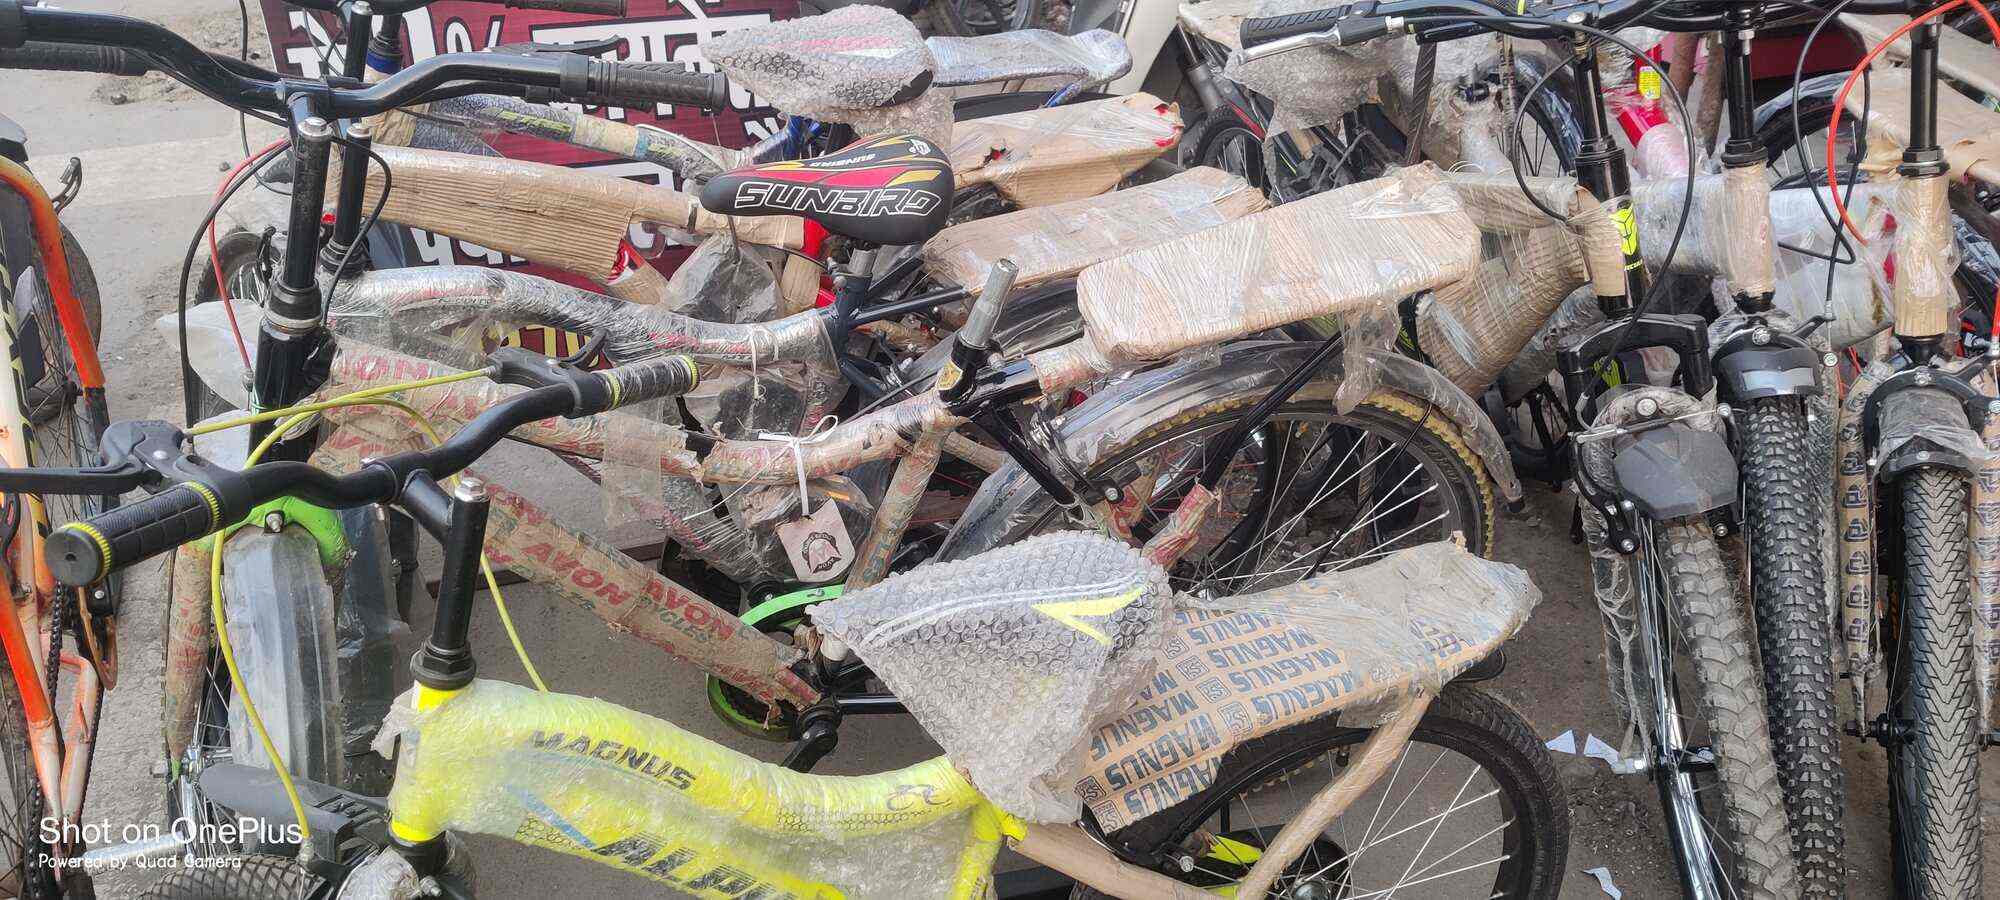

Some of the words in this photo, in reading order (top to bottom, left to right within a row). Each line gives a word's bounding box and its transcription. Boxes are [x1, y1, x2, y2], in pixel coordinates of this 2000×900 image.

[734, 181, 942, 217] SUNBIRD
[520, 542, 632, 606] AVON
[641, 577, 735, 640] AVON
[1206, 624, 1317, 669] MAGNUS
[1228, 646, 1342, 692] MAGNUS
[1252, 670, 1354, 726] MAGNUS
[531, 730, 696, 790] MAGNUS
[1104, 711, 1222, 791] MAGNUS
